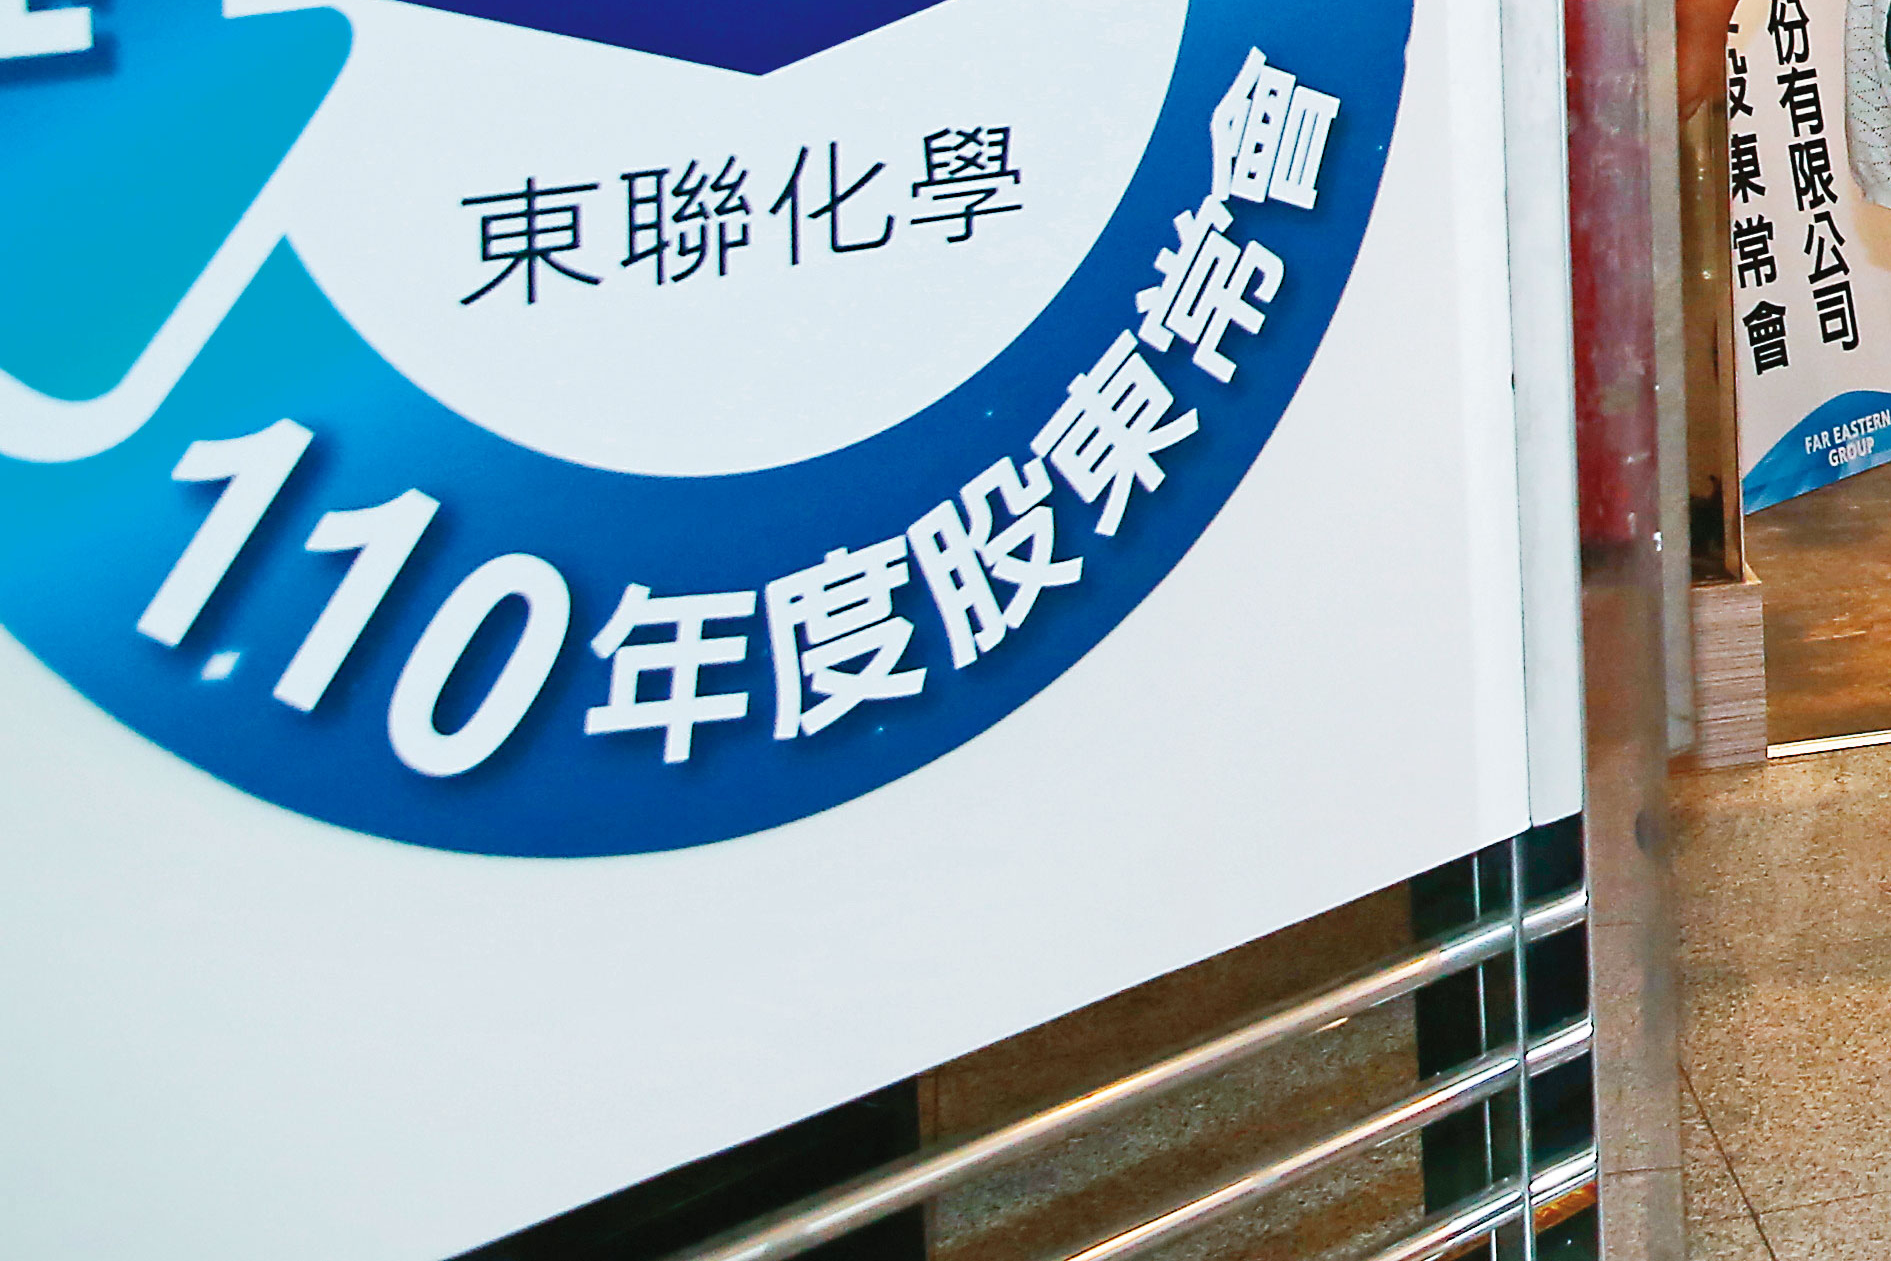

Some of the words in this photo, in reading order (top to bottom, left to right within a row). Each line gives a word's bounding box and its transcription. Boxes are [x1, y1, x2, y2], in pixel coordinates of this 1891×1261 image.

[459, 125, 1024, 307] 東聯化學
[135, 45, 1341, 779] 110年度股東常會
[1804, 431, 1831, 455] FAR
[1832, 409, 1891, 444] EASTERN
[1828, 436, 1875, 467] GROUP
